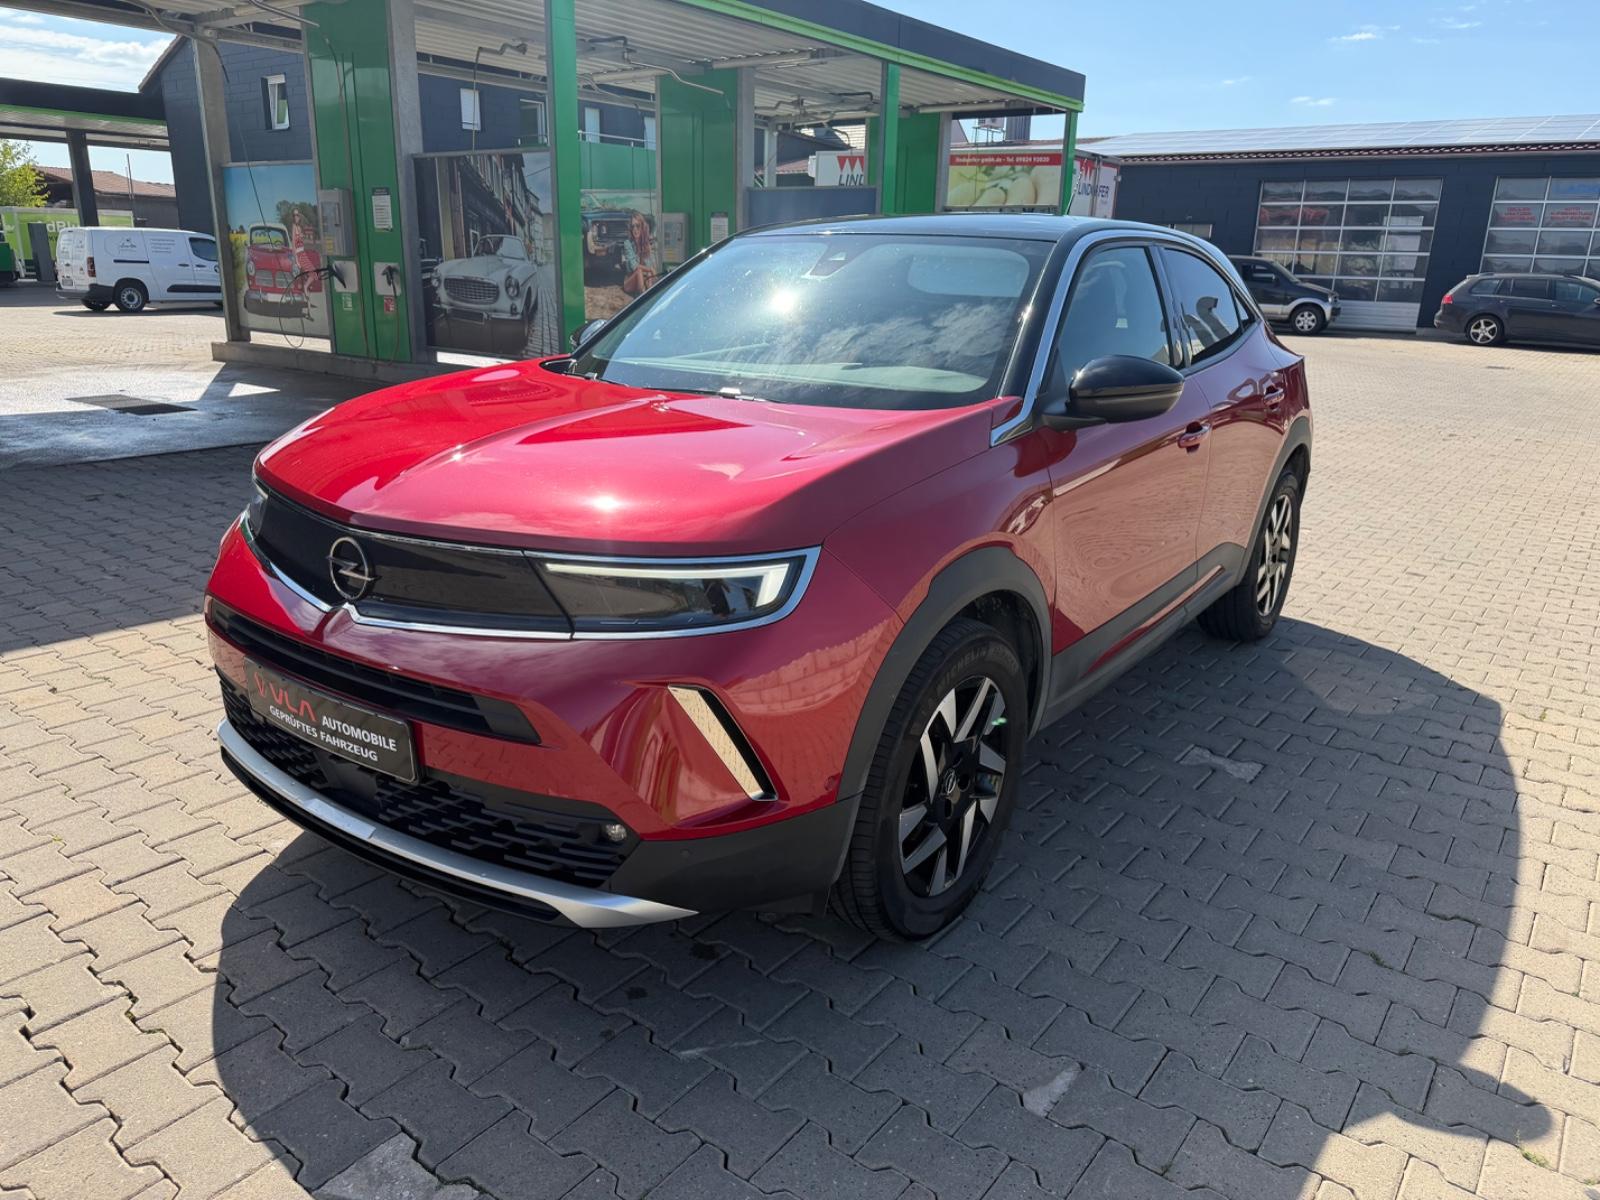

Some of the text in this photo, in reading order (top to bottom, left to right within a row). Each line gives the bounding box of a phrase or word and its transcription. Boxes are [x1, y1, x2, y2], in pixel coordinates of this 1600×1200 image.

[269, 704, 378, 762] GEPRÜFTES FAHRZEUG
[322, 715, 397, 751] AUTOMOBILE
